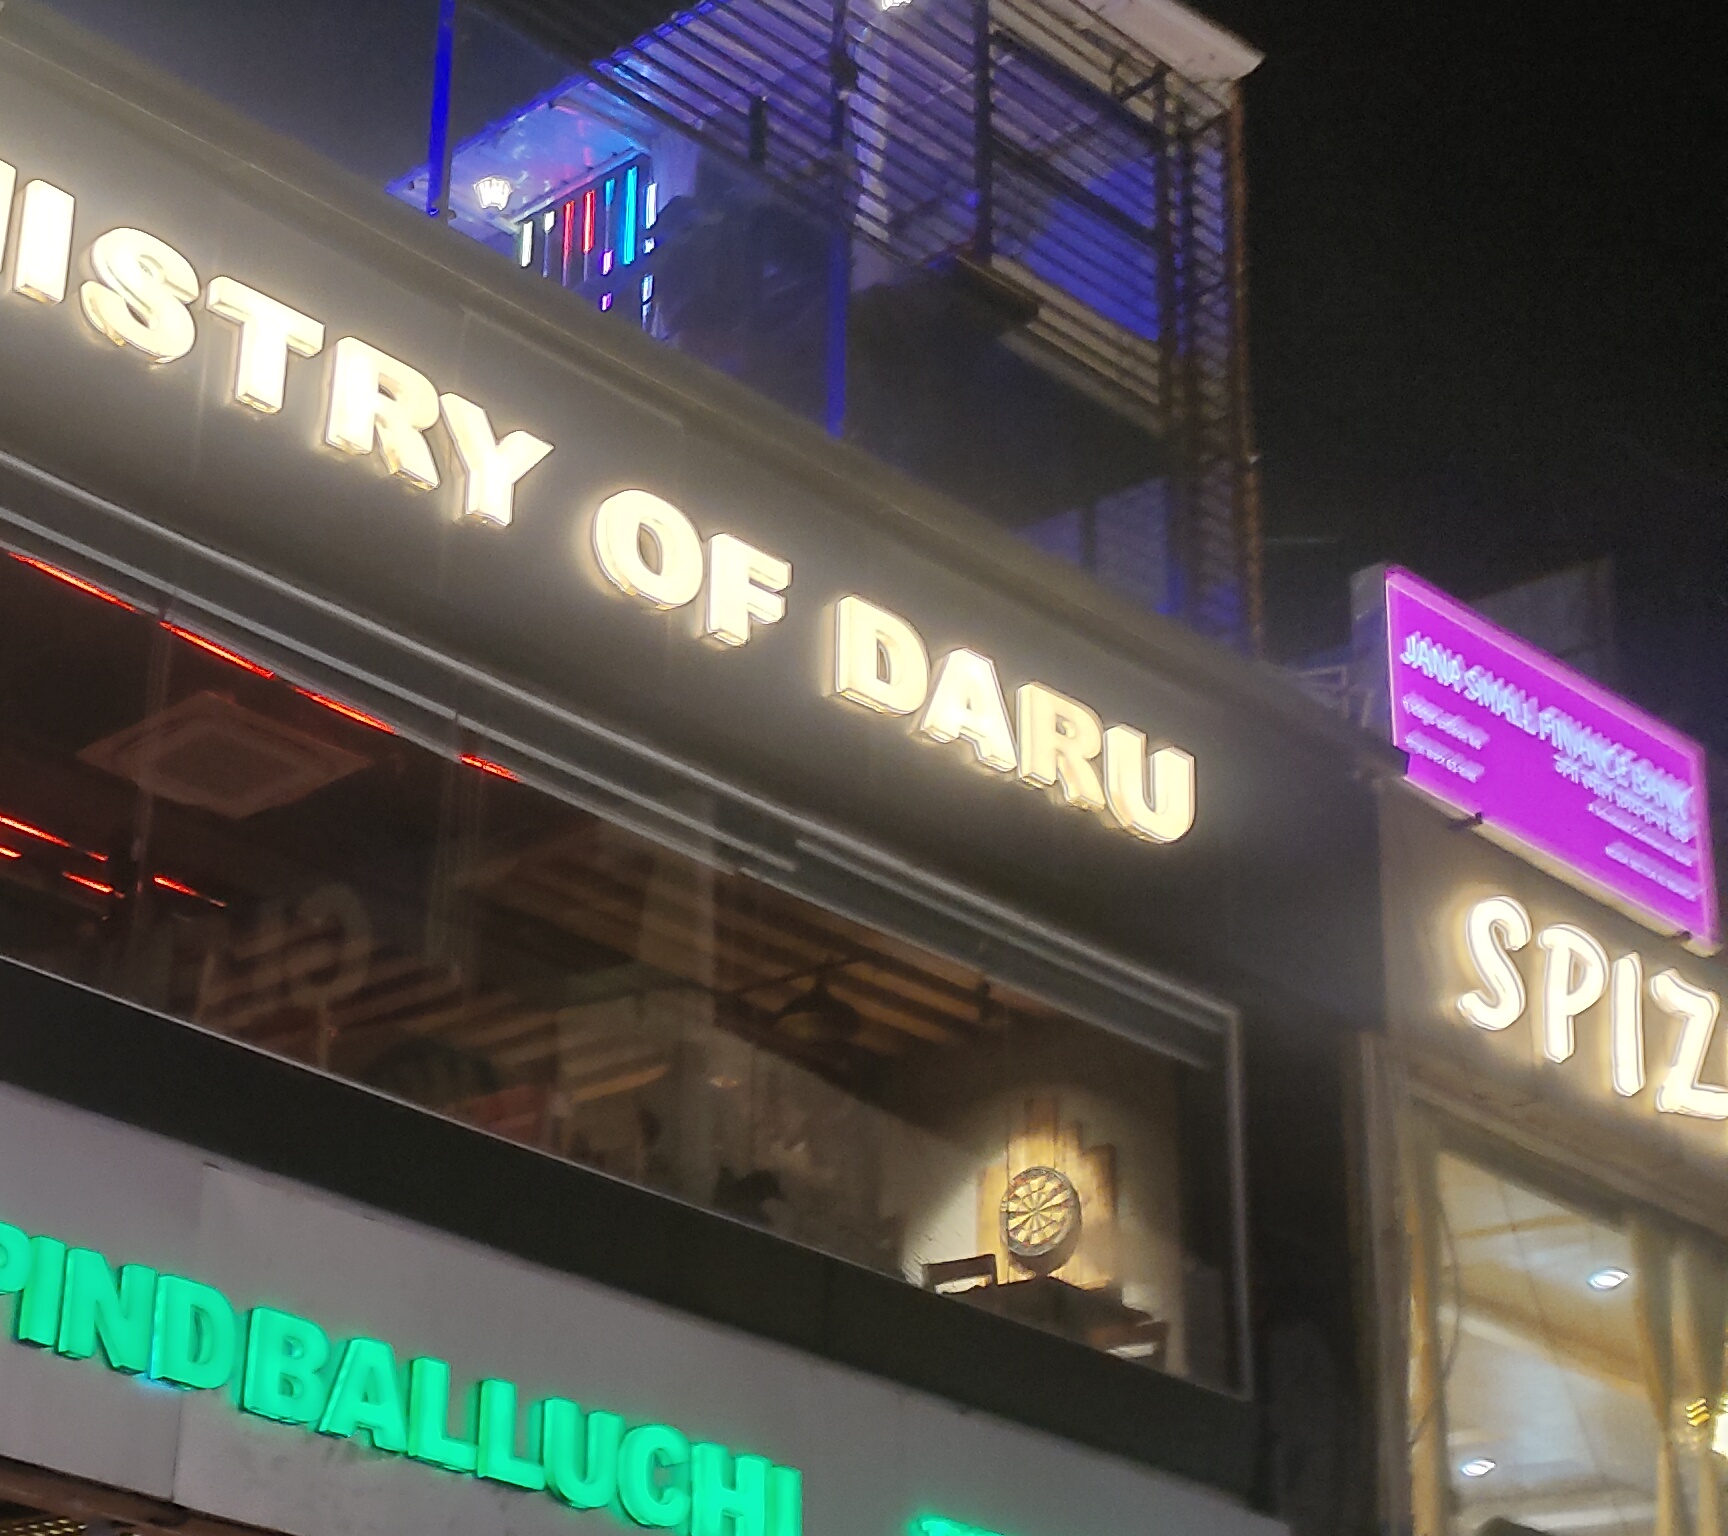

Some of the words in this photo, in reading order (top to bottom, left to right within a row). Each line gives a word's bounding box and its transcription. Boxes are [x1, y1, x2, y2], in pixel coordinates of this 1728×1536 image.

[591, 488, 793, 647] OF
[832, 594, 1196, 845] DARU
[1399, 630, 1466, 695] JANA
[1463, 664, 1540, 736] SMALL
